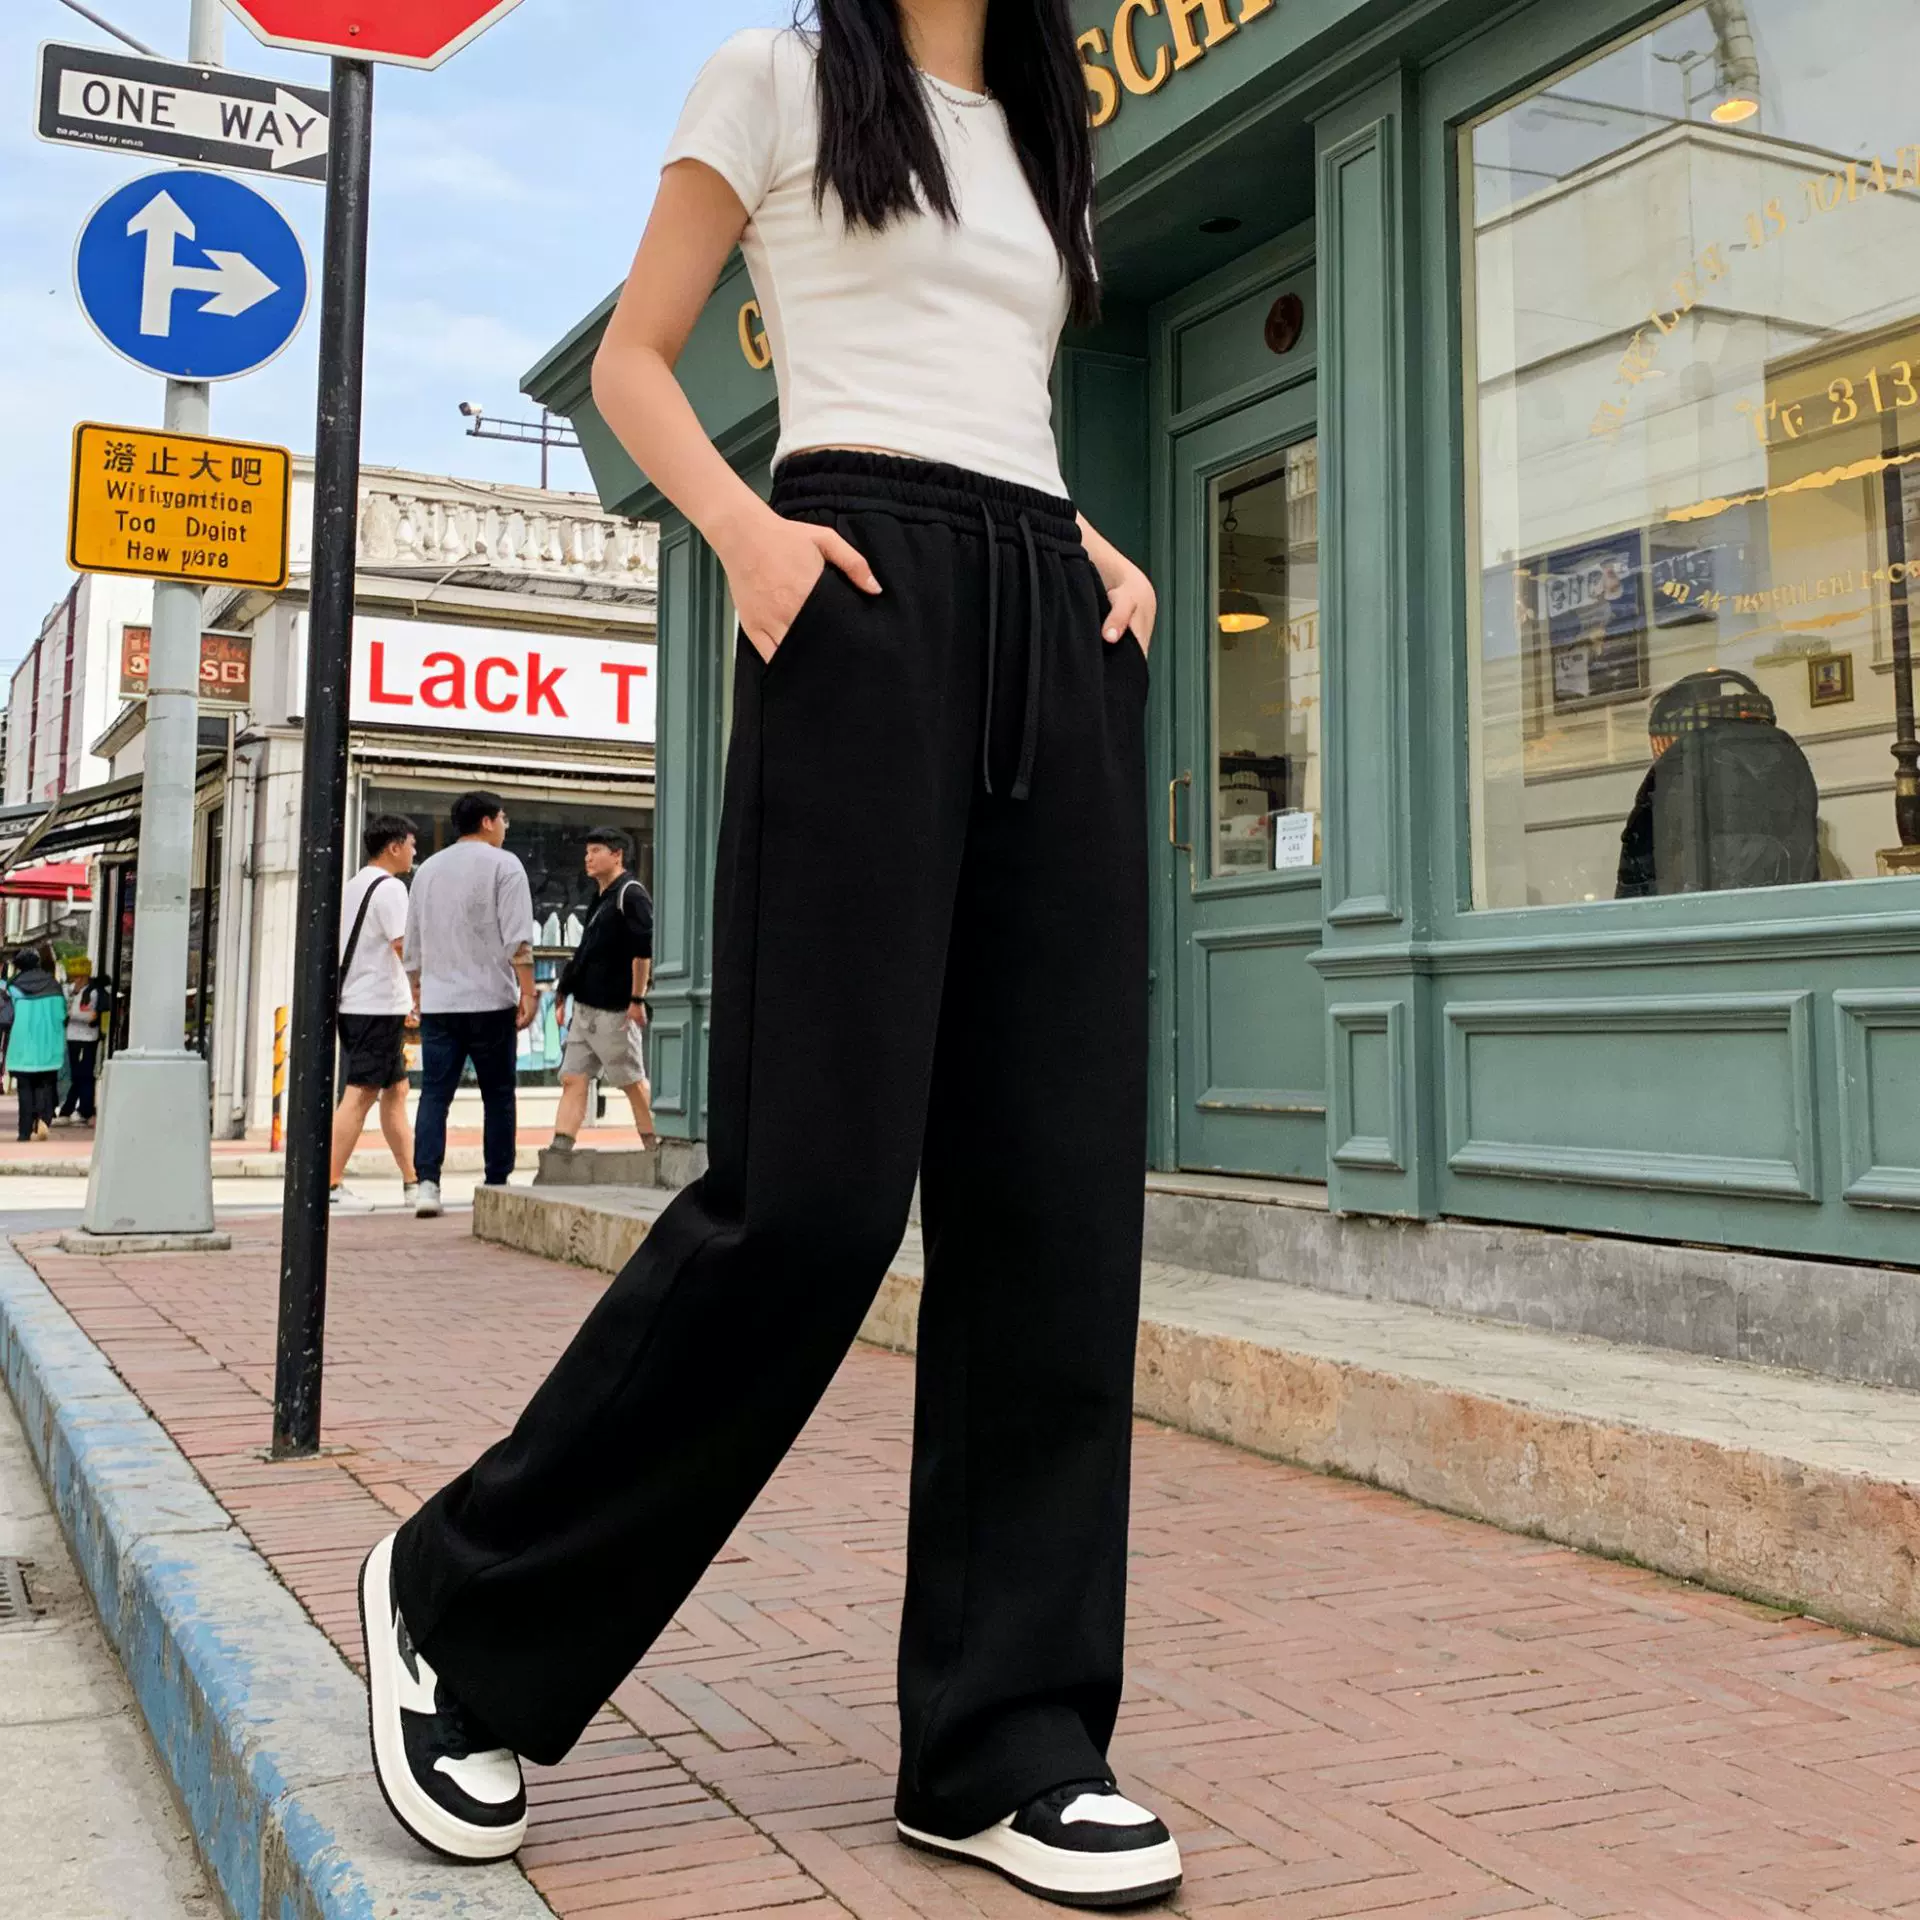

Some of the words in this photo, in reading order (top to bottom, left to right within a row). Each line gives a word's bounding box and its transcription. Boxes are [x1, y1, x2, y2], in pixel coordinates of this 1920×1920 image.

[1076, 0, 1275, 128] SCH
[82, 79, 176, 128] ONE
[220, 101, 316, 148] WAY
[738, 299, 771, 370] G
[127, 539, 170, 562] Haw
[369, 641, 569, 718] Lack
[600, 662, 648, 724] T
